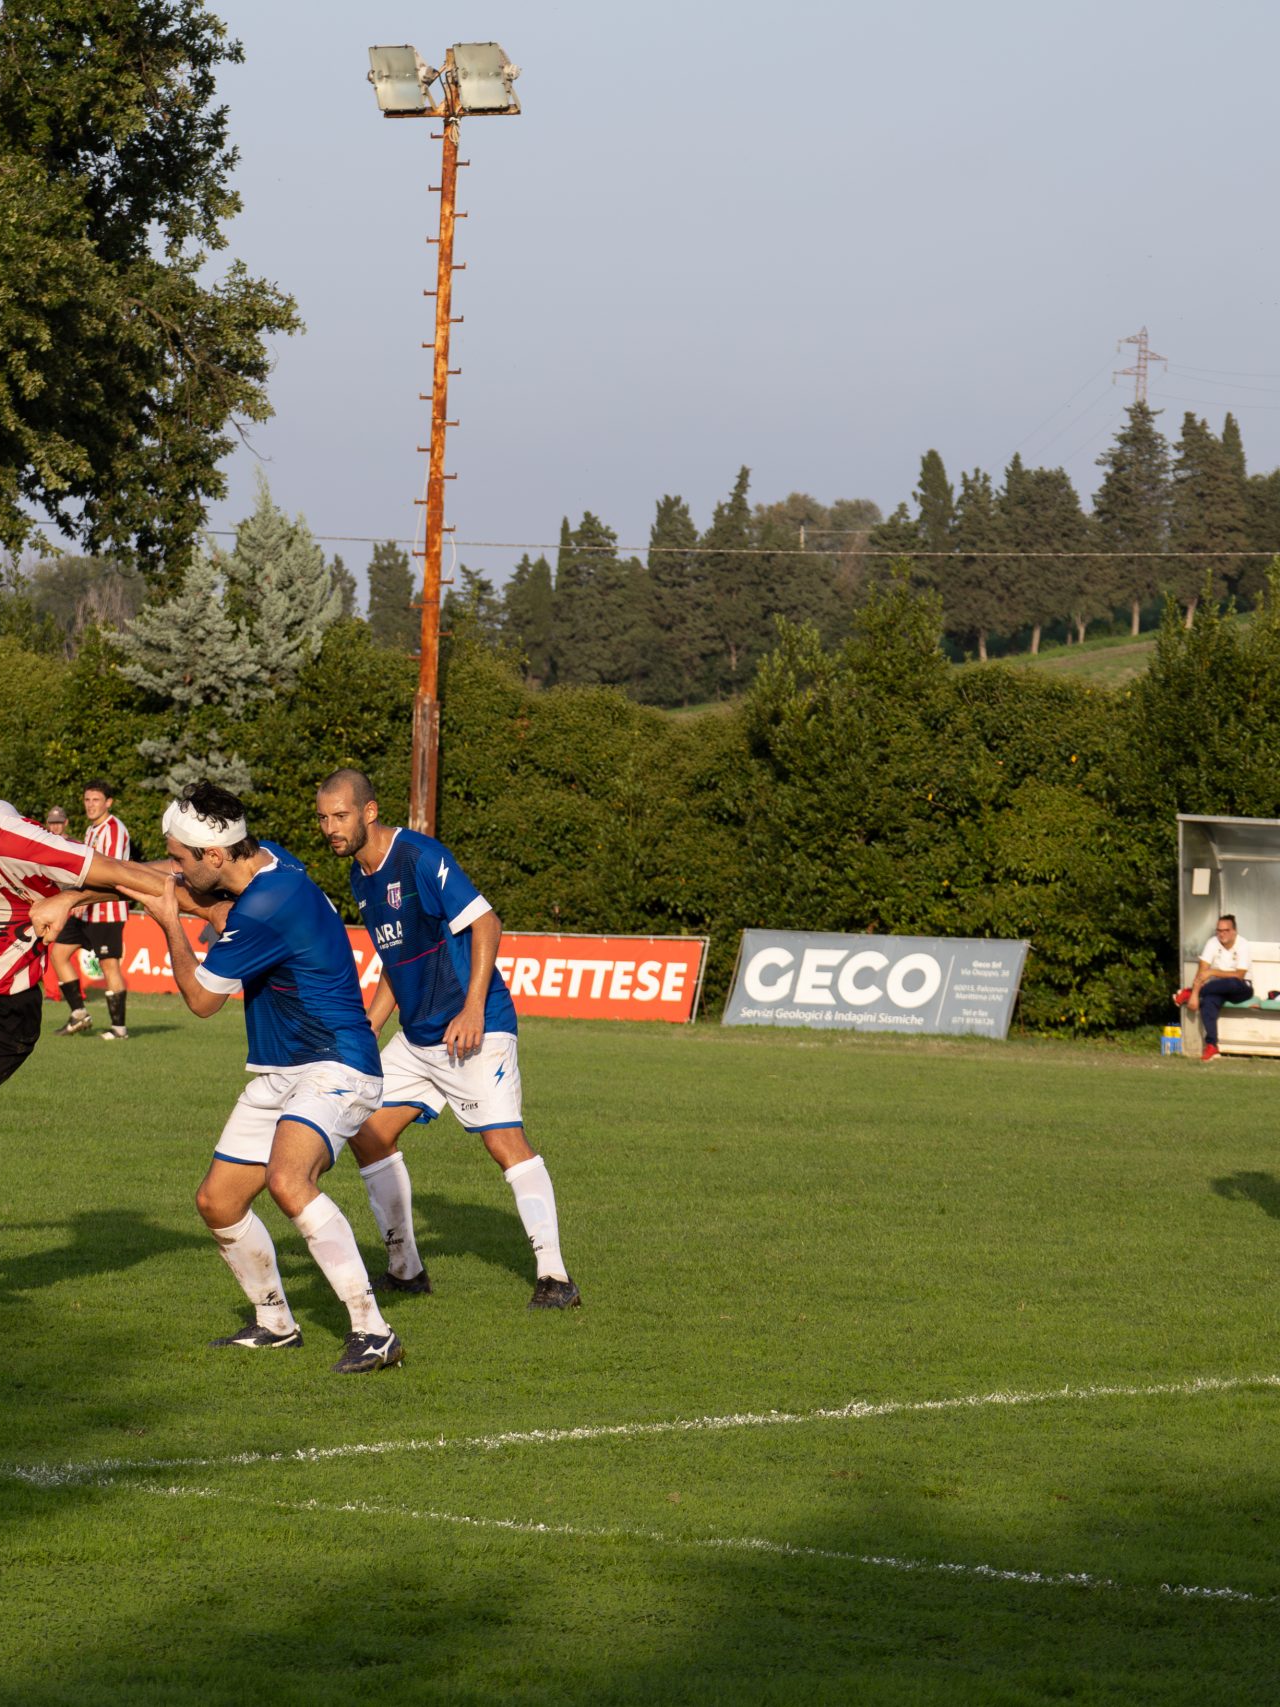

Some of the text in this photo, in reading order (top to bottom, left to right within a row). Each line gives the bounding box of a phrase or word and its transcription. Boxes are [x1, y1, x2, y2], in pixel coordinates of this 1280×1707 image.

[744, 947, 942, 1009] GECO
[740, 1006, 924, 1026] Servizi Geologici & Indagini Sismiche
